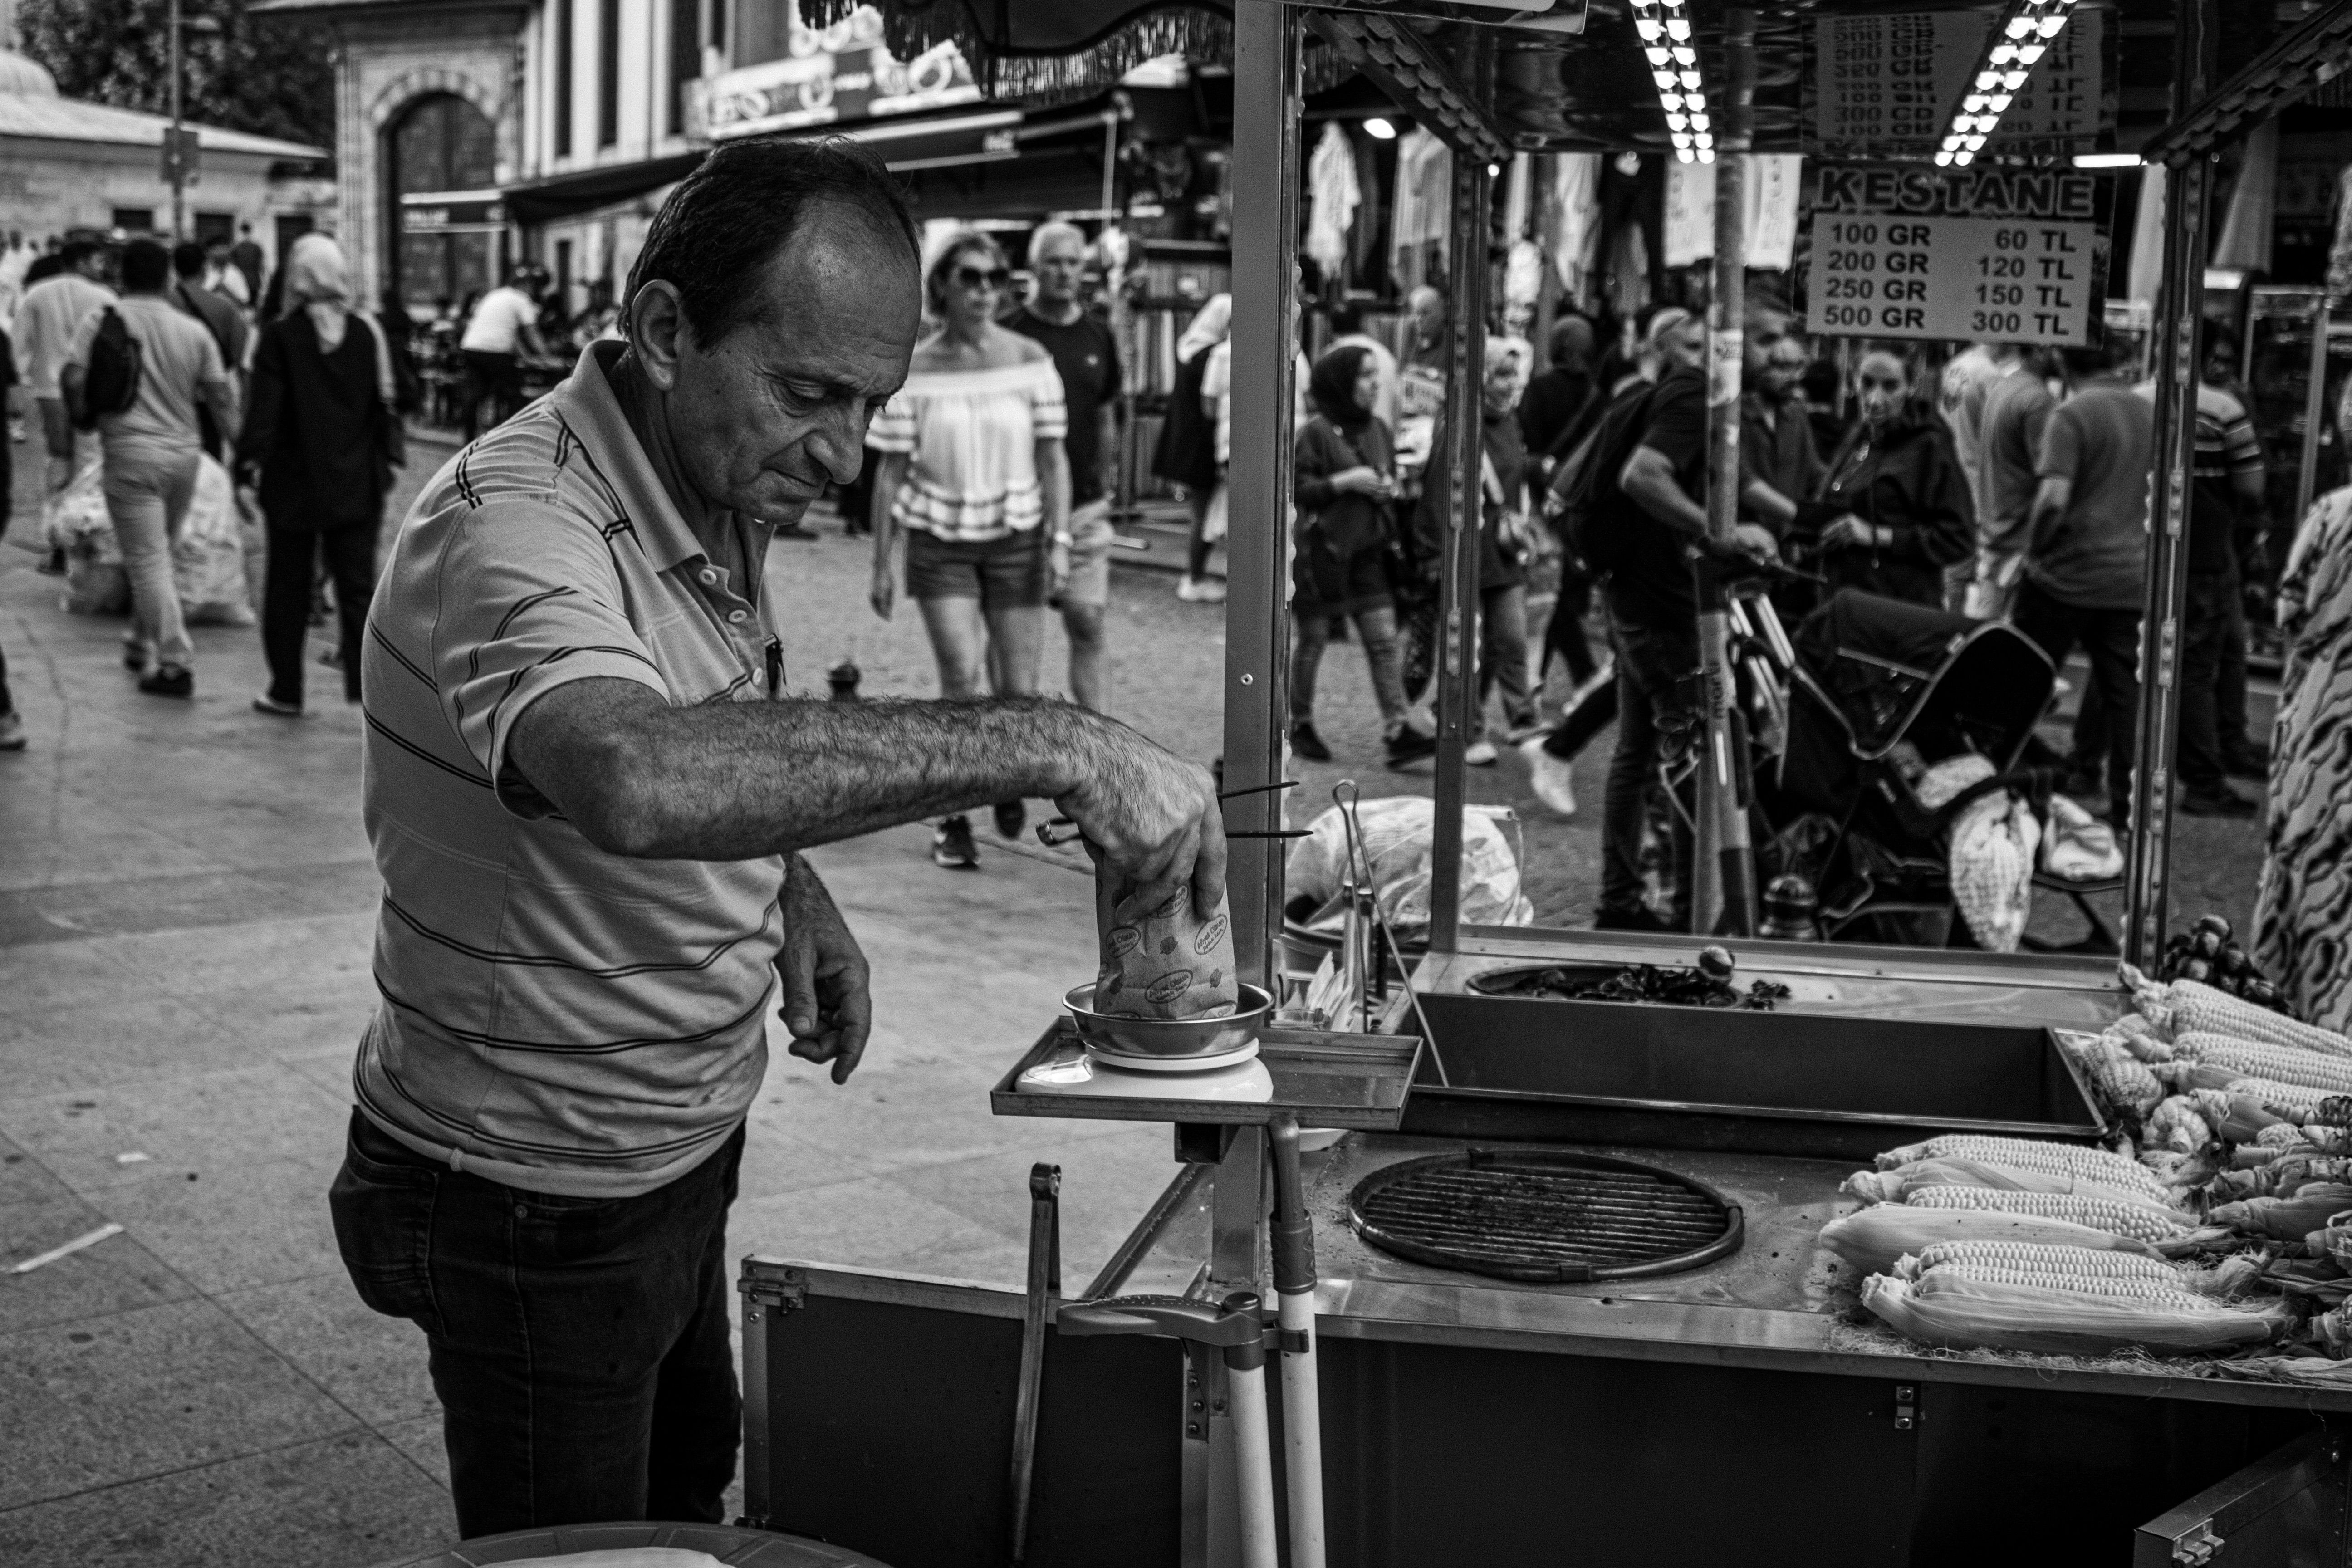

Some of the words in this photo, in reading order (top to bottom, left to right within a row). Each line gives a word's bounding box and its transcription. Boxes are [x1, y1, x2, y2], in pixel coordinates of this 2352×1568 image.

[1814, 169, 2095, 216] KESTANE
[1831, 222, 1878, 245] 100
[1886, 223, 1931, 247] GR
[1994, 228, 2028, 250] 60
[2040, 229, 2077, 253] TL
[1828, 249, 1876, 272] 200
[1884, 250, 1929, 274] GR
[1978, 255, 2026, 278] 120
[2038, 257, 2074, 280] TL
[1826, 277, 1874, 299] 250
[1882, 278, 1927, 302] GR
[1976, 284, 2024, 306] 150
[2035, 284, 2072, 309] TL
[1824, 304, 1872, 327] 500
[1881, 306, 1925, 329] GR
[1972, 310, 2021, 333] 300
[2033, 312, 2069, 336] TL
